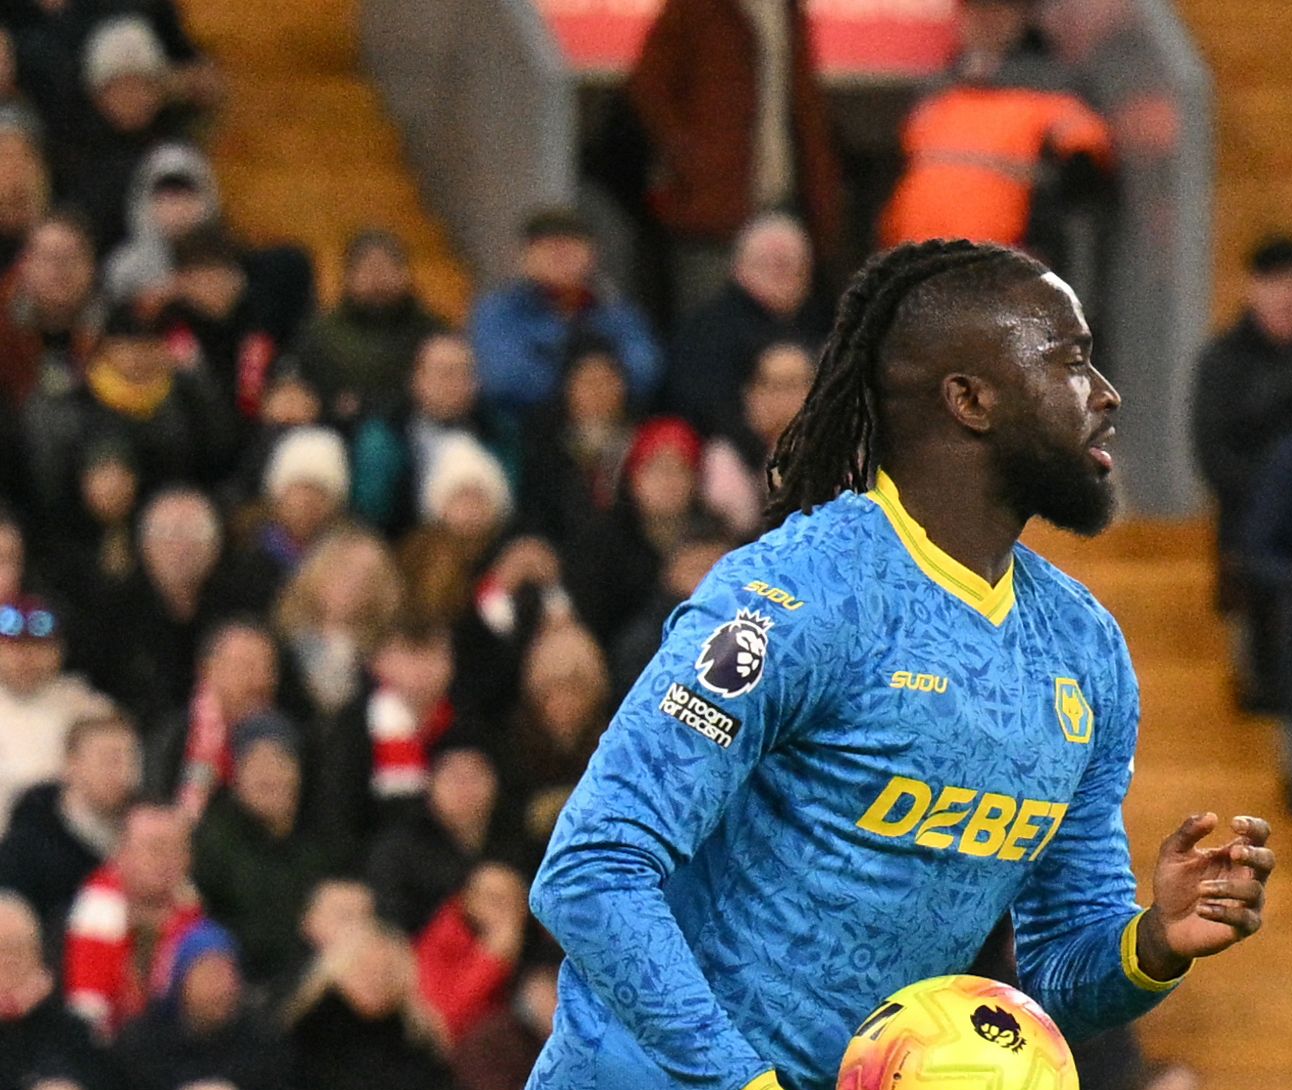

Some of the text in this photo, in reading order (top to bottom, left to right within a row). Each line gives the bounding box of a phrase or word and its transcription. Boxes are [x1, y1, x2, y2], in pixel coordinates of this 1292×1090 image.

[744, 580, 804, 610] SUDU
[890, 671, 948, 693] SUDU
[665, 683, 734, 732] No room
[678, 708, 732, 748] racism
[856, 775, 1070, 861] DEBET
